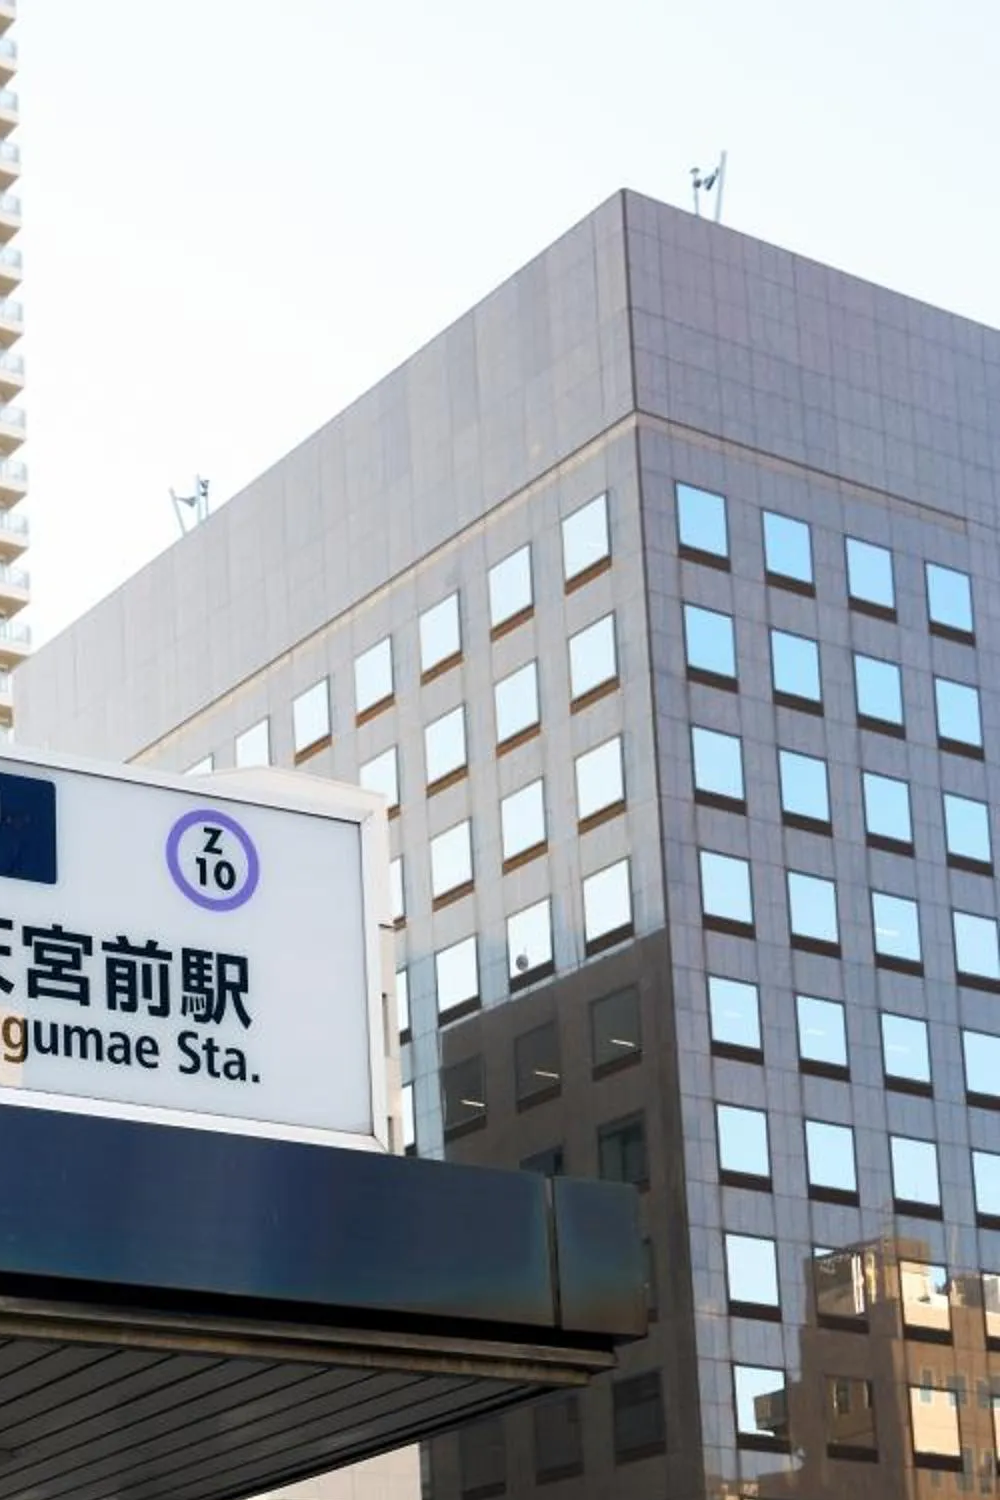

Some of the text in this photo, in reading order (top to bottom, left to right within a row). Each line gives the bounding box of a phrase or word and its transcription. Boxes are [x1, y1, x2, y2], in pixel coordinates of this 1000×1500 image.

[203, 827, 224, 854] Z
[195, 858, 238, 892] 10
[178, 1031, 262, 1083] Sta.
